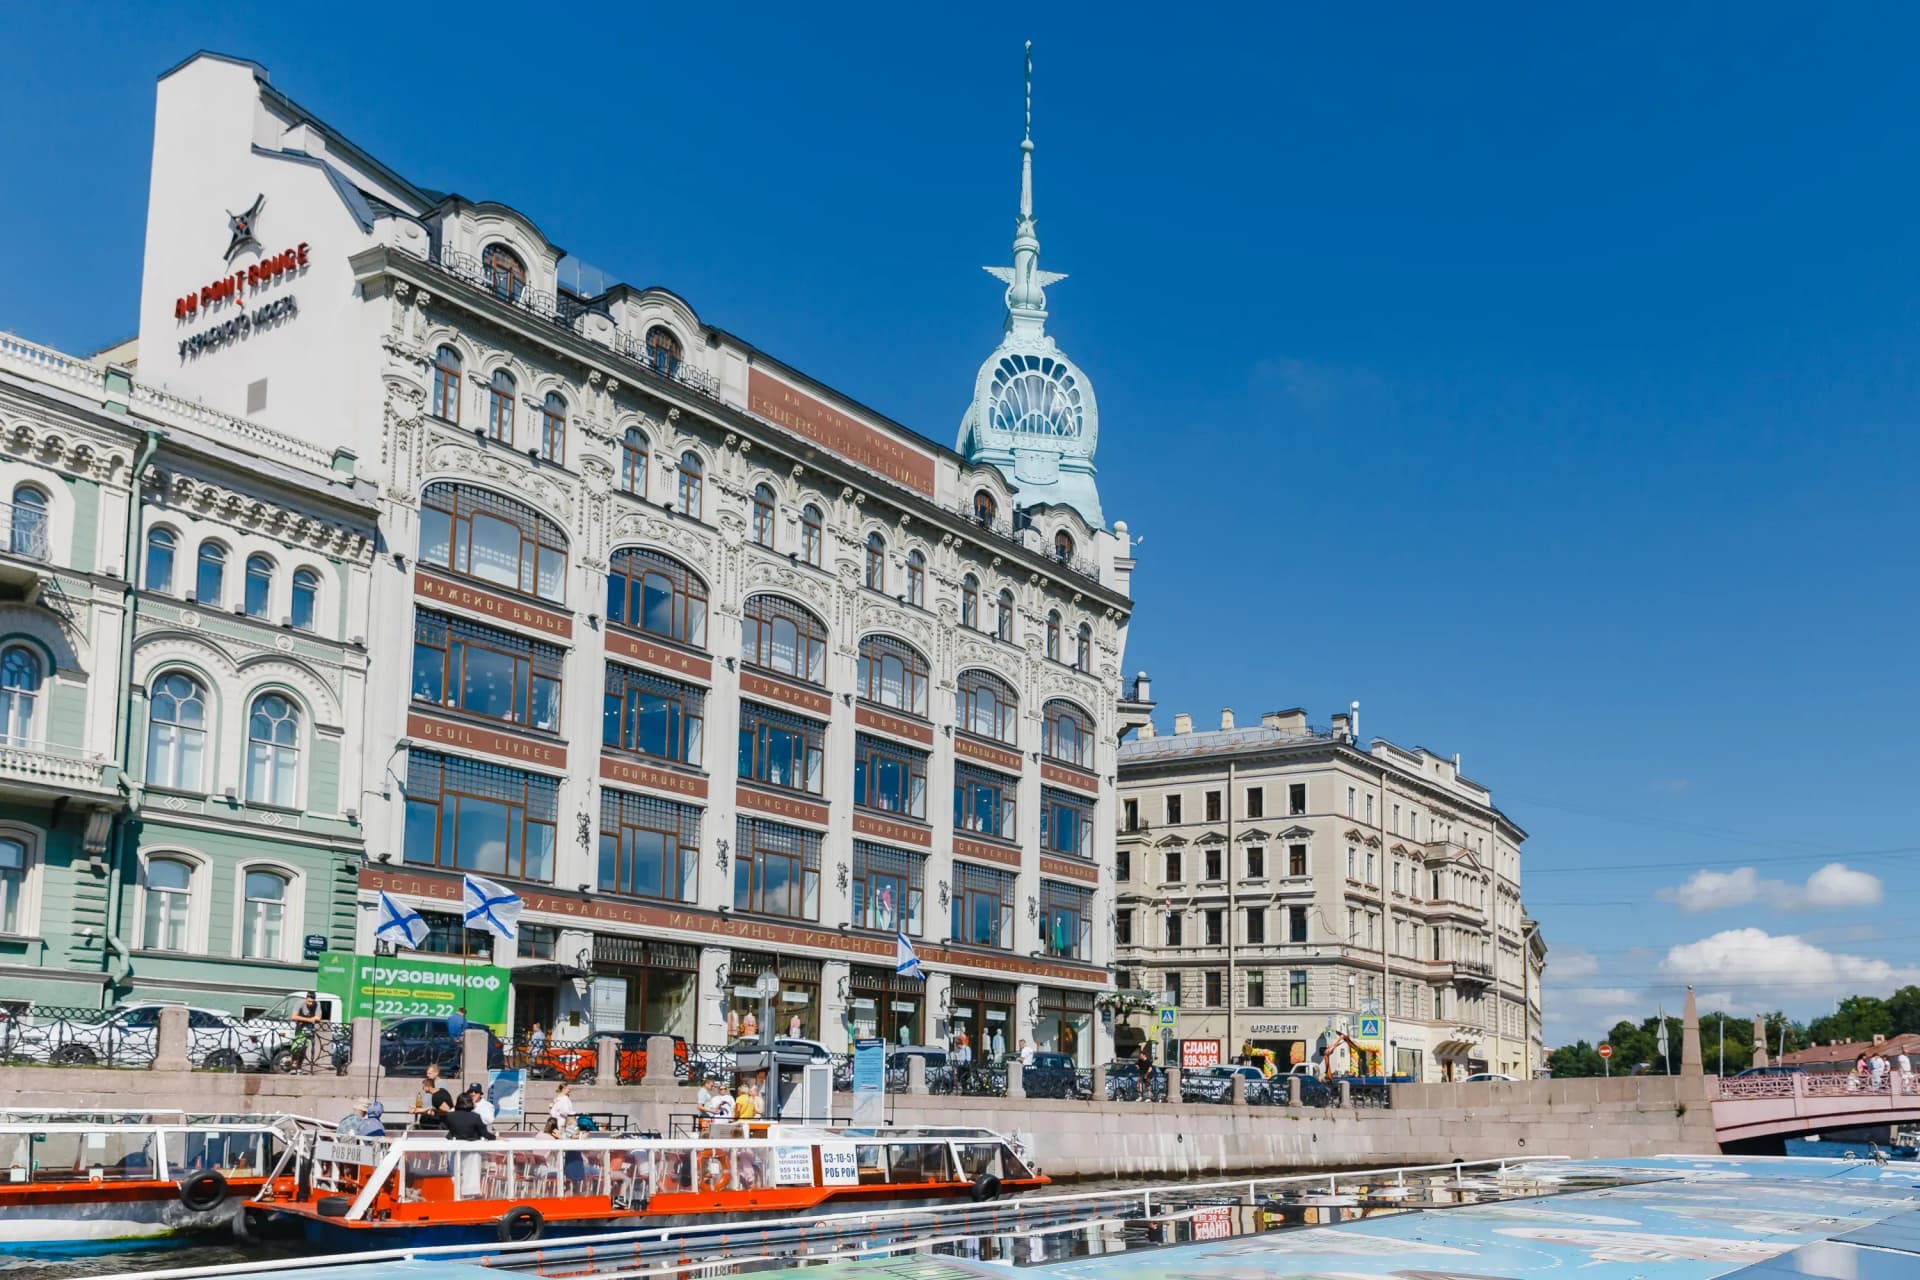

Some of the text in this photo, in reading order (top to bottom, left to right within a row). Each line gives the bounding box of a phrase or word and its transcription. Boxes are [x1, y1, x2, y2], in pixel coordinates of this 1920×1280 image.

[175, 242, 309, 319] AU PONT ROUGE
[752, 394, 817, 437] ESDERS
[423, 580, 504, 613] МУЖСКОЕ
[630, 643, 688, 669] ЮБКИ
[424, 723, 473, 744] DEUIL
[613, 765, 695, 791] FOURRURES
[747, 793, 817, 818] LINGERIE
[372, 876, 456, 897] ЭСДЕР
[669, 913, 776, 939] МАГАЗИНЪ
[787, 930, 796, 943] У
[361, 966, 500, 991] грузовичкоф
[375, 1000, 454, 1018] 222-22-22
[1184, 1041, 1219, 1054] СДАНО
[825, 1167, 840, 1178] РОБ
